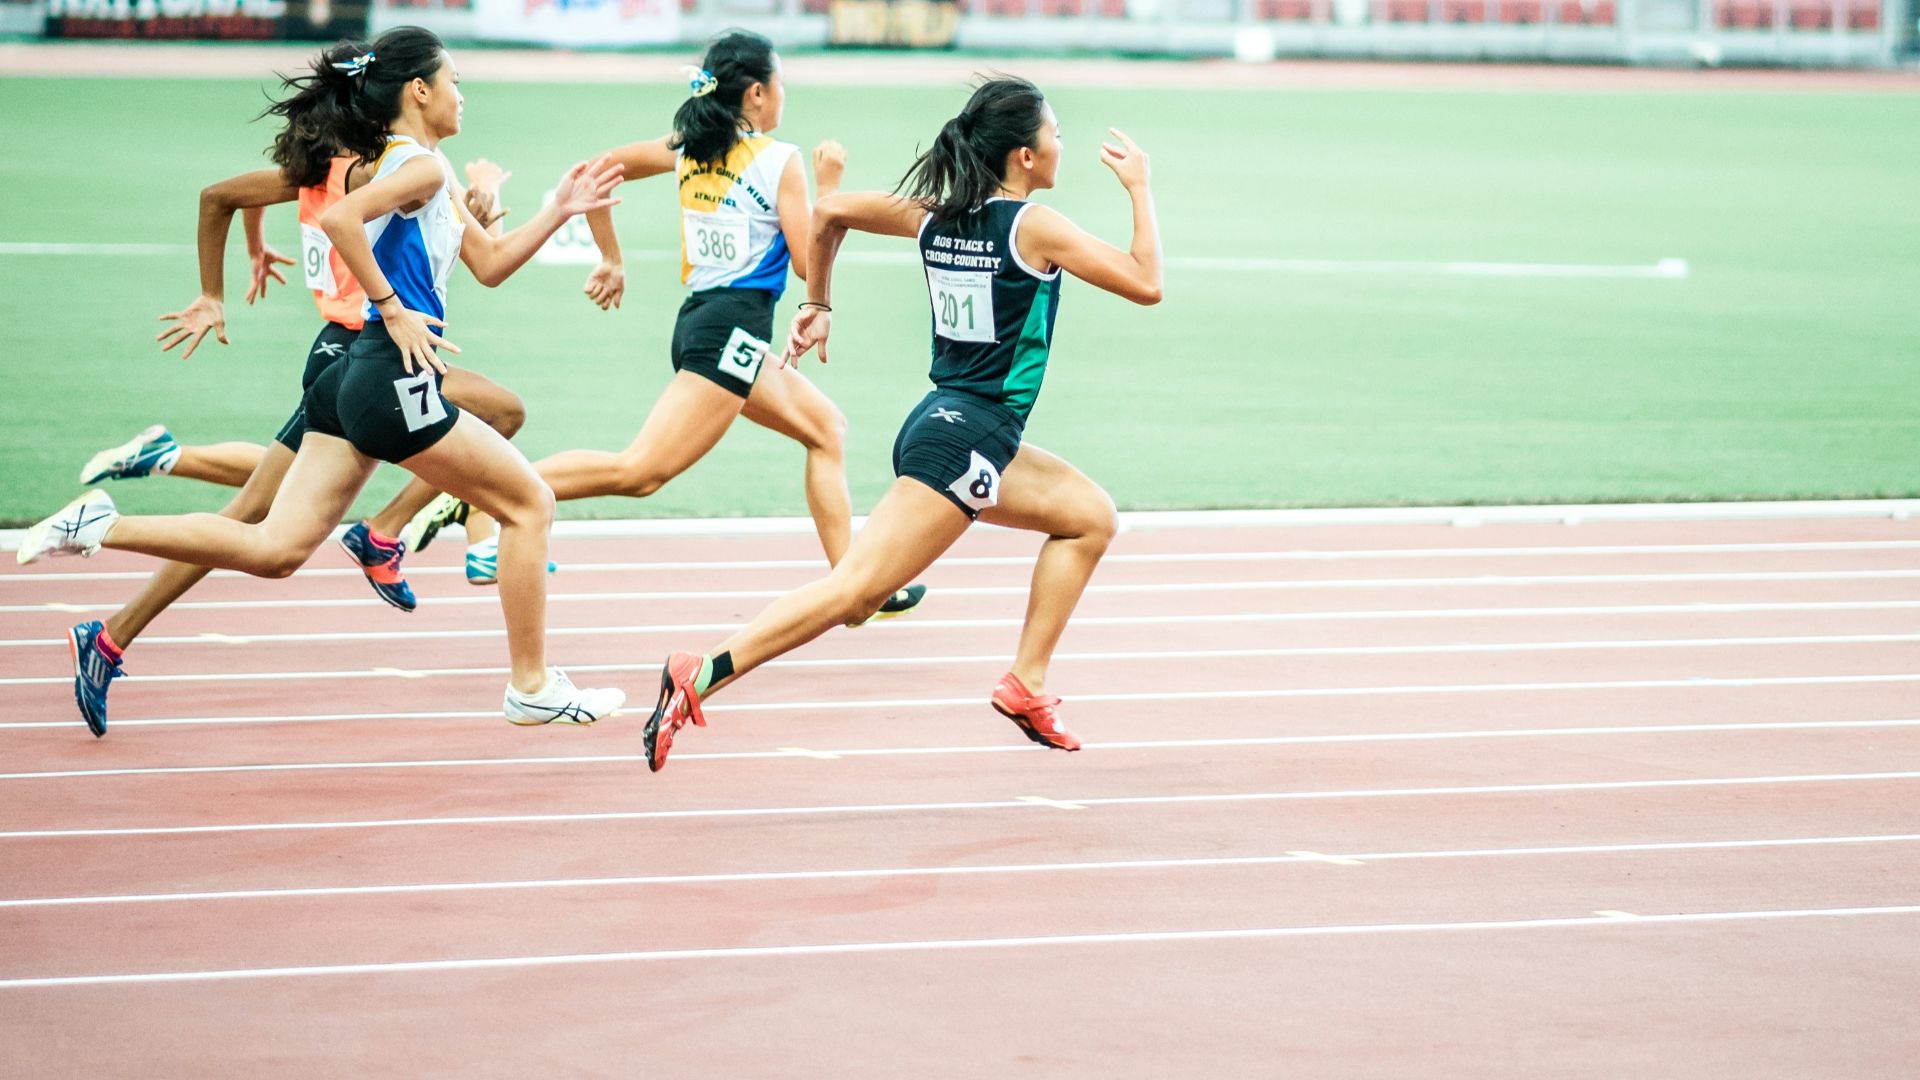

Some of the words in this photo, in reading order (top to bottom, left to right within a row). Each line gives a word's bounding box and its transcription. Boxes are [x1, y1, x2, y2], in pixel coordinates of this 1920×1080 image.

[697, 228, 736, 261] 386
[932, 235, 952, 249] RGS
[953, 237, 984, 252] TRACK
[925, 249, 1002, 269] CROSS-COUNTRY
[938, 290, 975, 330] 201
[733, 340, 757, 368] 5
[407, 380, 429, 416] 7
[969, 469, 993, 499] 8
